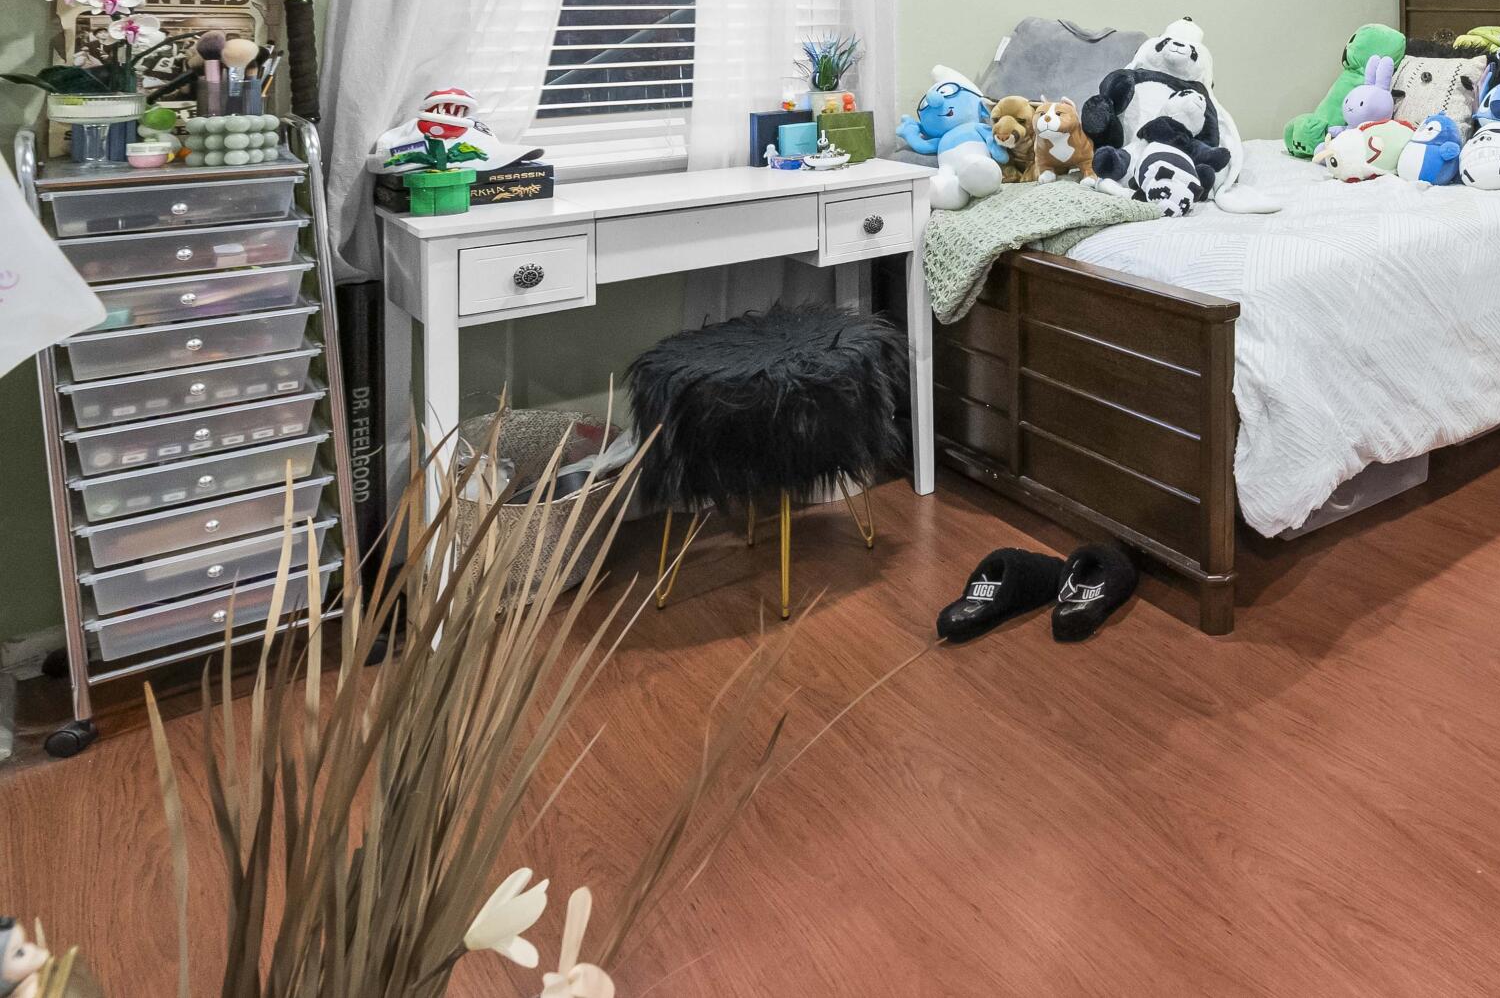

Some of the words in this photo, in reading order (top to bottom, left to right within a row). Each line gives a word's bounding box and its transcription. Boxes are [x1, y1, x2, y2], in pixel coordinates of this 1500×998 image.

[489, 171, 546, 182] ASSASSIN
[352, 386, 370, 415] DR.
[351, 416, 378, 503] FEELGOOD
[972, 584, 995, 597] UGG
[1081, 587, 1102, 600] UGG
